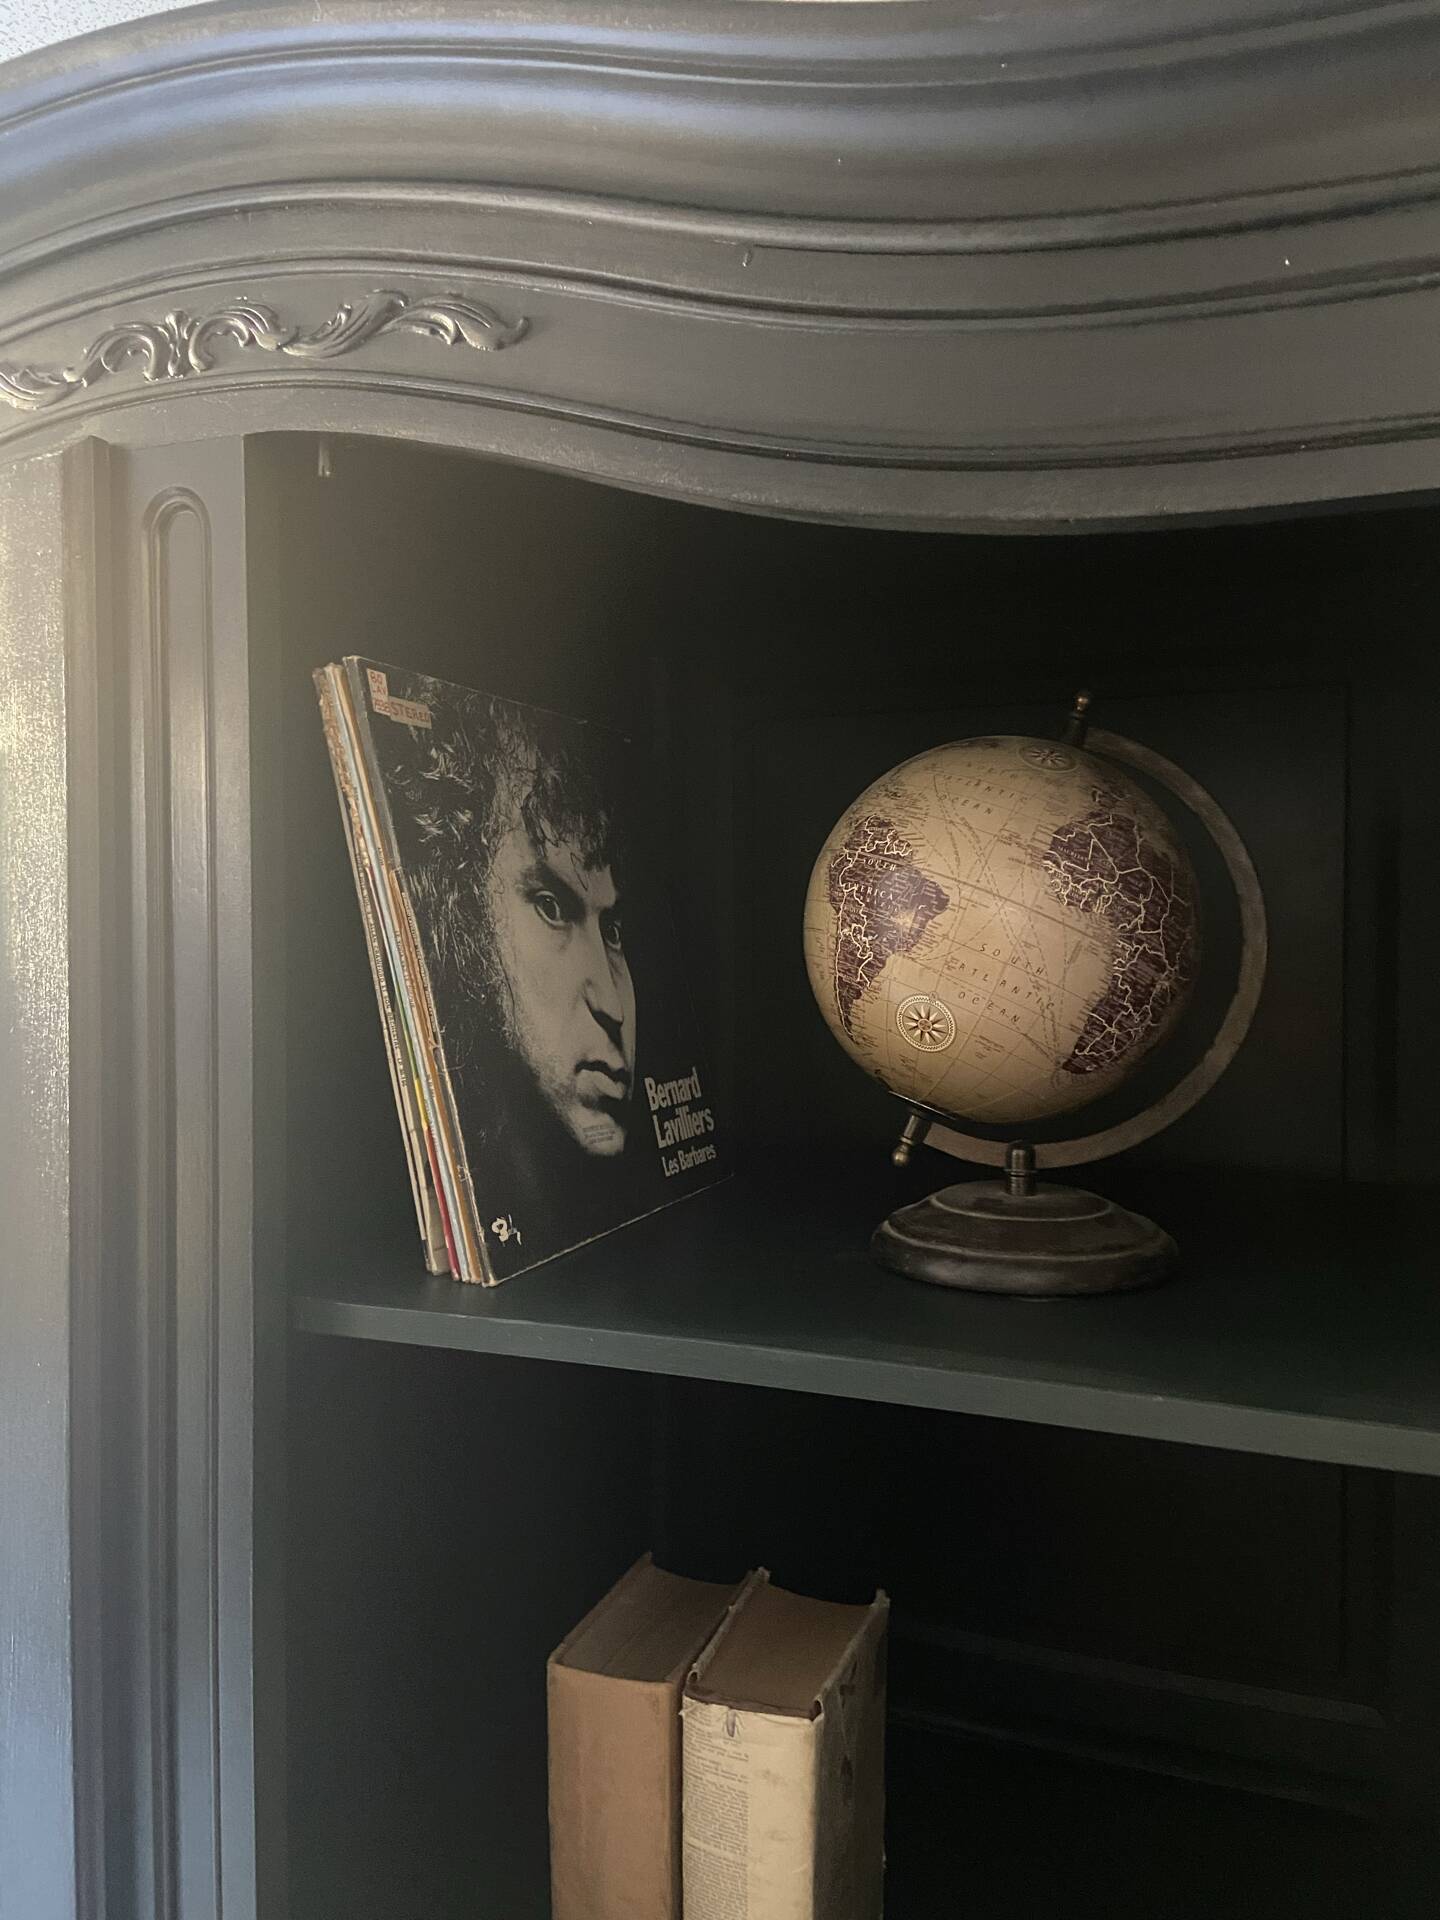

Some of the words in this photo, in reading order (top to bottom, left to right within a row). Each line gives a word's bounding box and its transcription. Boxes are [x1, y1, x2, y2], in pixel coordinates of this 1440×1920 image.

[979, 943, 1044, 975] SOUTH
[958, 962, 1055, 1010] ATLANTIC
[958, 991, 1021, 1022] OCEAN
[644, 1066, 702, 1111] Bernard
[652, 1105, 715, 1149] Lavilliers
[661, 1156, 680, 1177] Les
[677, 1143, 717, 1171] Barbares
